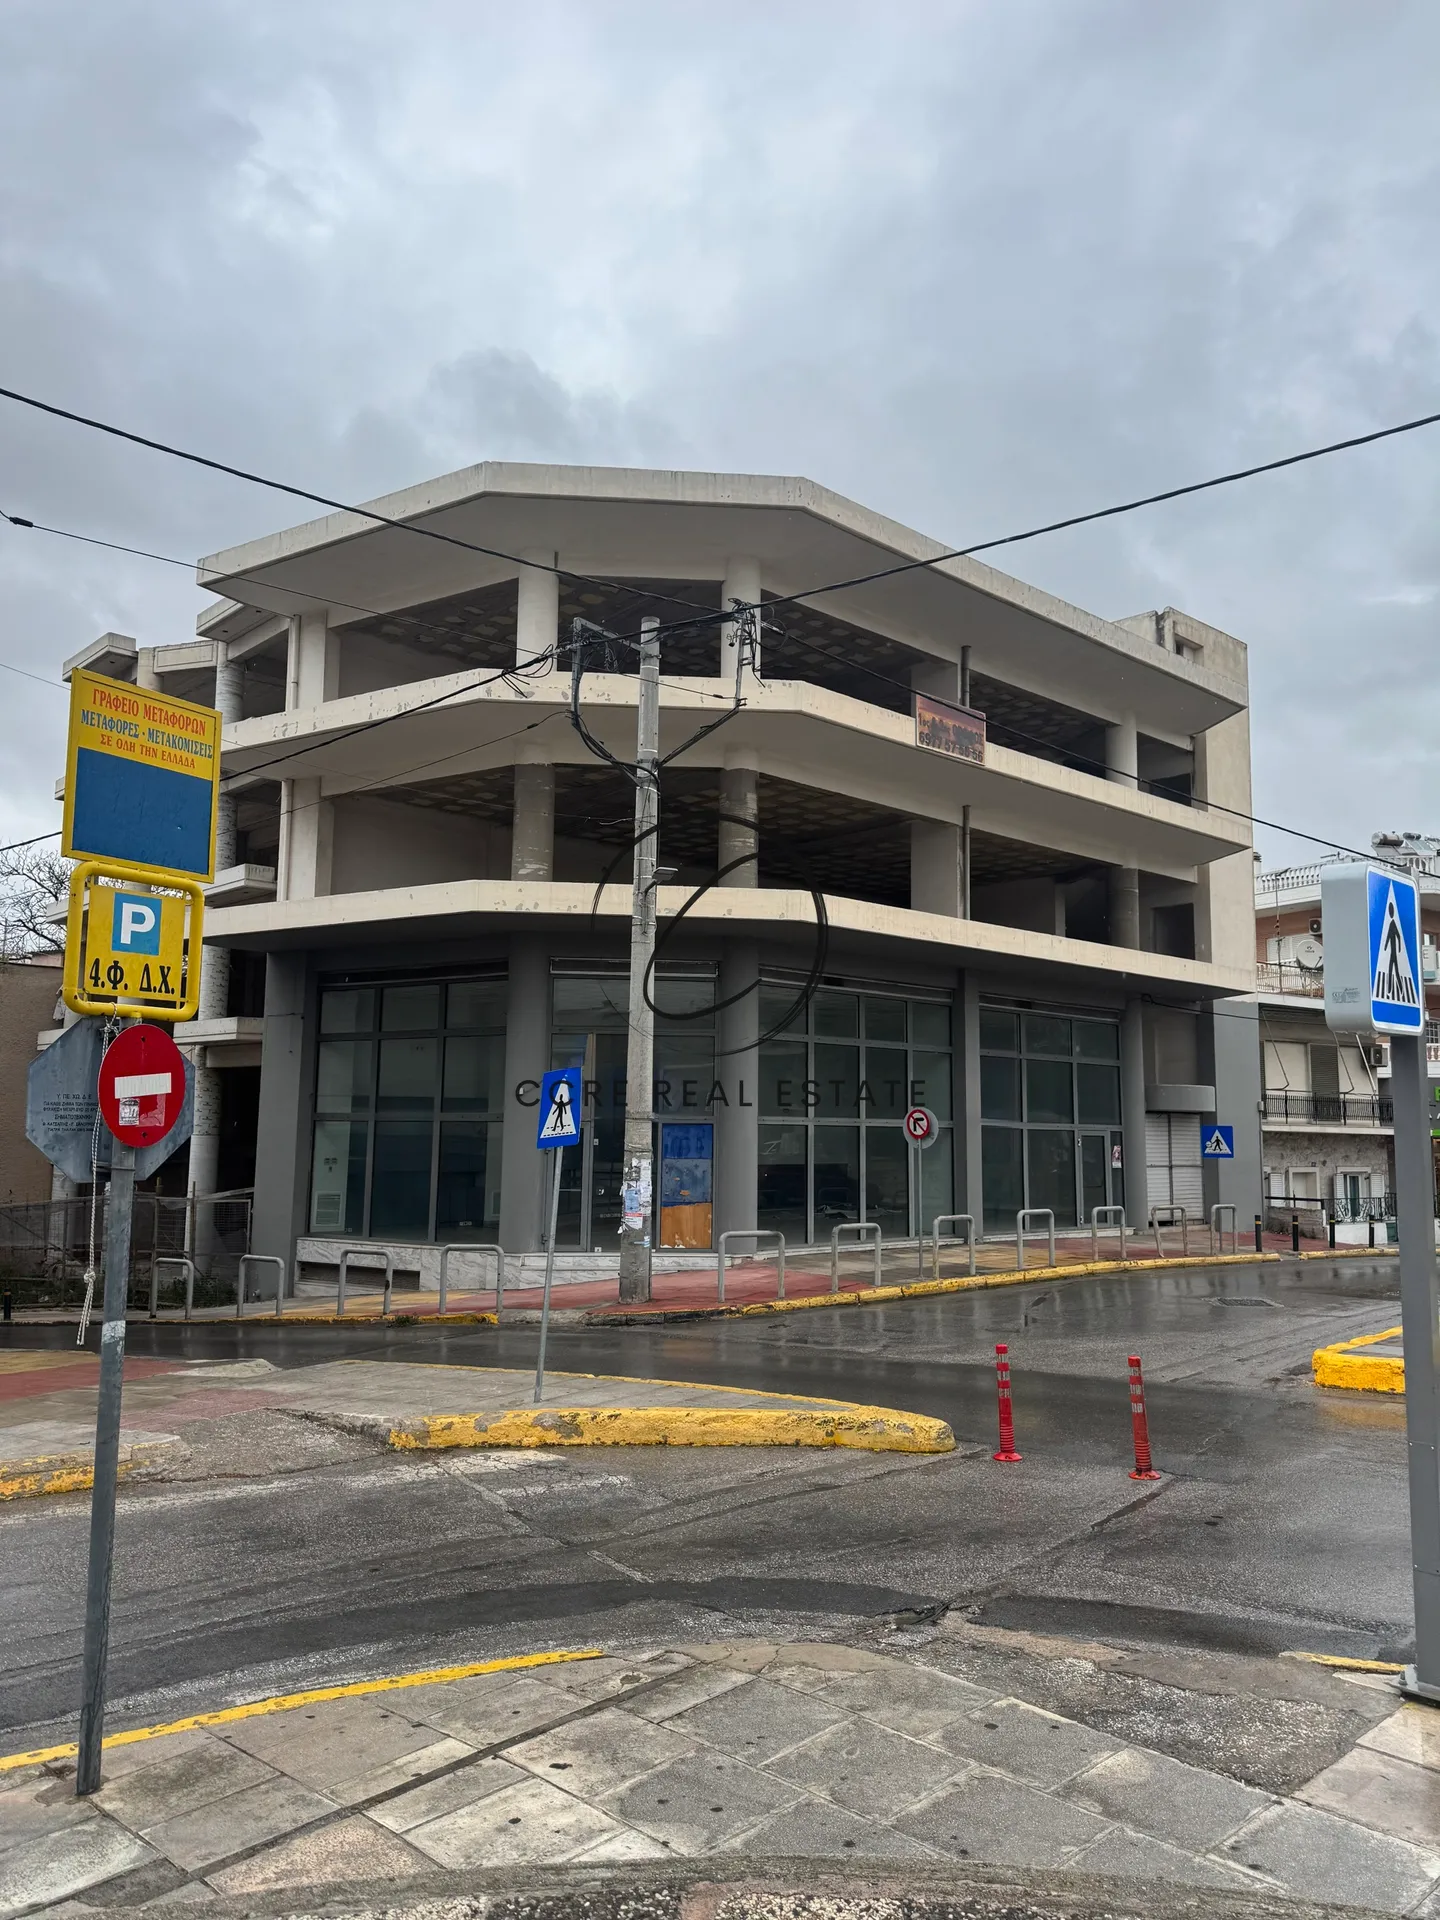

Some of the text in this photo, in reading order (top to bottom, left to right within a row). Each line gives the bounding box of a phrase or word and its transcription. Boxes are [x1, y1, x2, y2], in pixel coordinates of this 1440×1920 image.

[81, 709, 213, 759] ΜΕΤΑΦΟΡΕΣ ΜΕΤΑΚΟΜΙΣΕΙΣ
[92, 688, 206, 737] ΓΡΑΦΕΙΟ ΜΕΤΑΦΟΡΩΝ
[100, 733, 196, 769] ΣΕ ΟΛΗ ΤΗΝ ΕΛΛΑΔΑ
[120, 902, 156, 945] P
[89, 957, 175, 995] 4.Φ. Δ.Χ.
